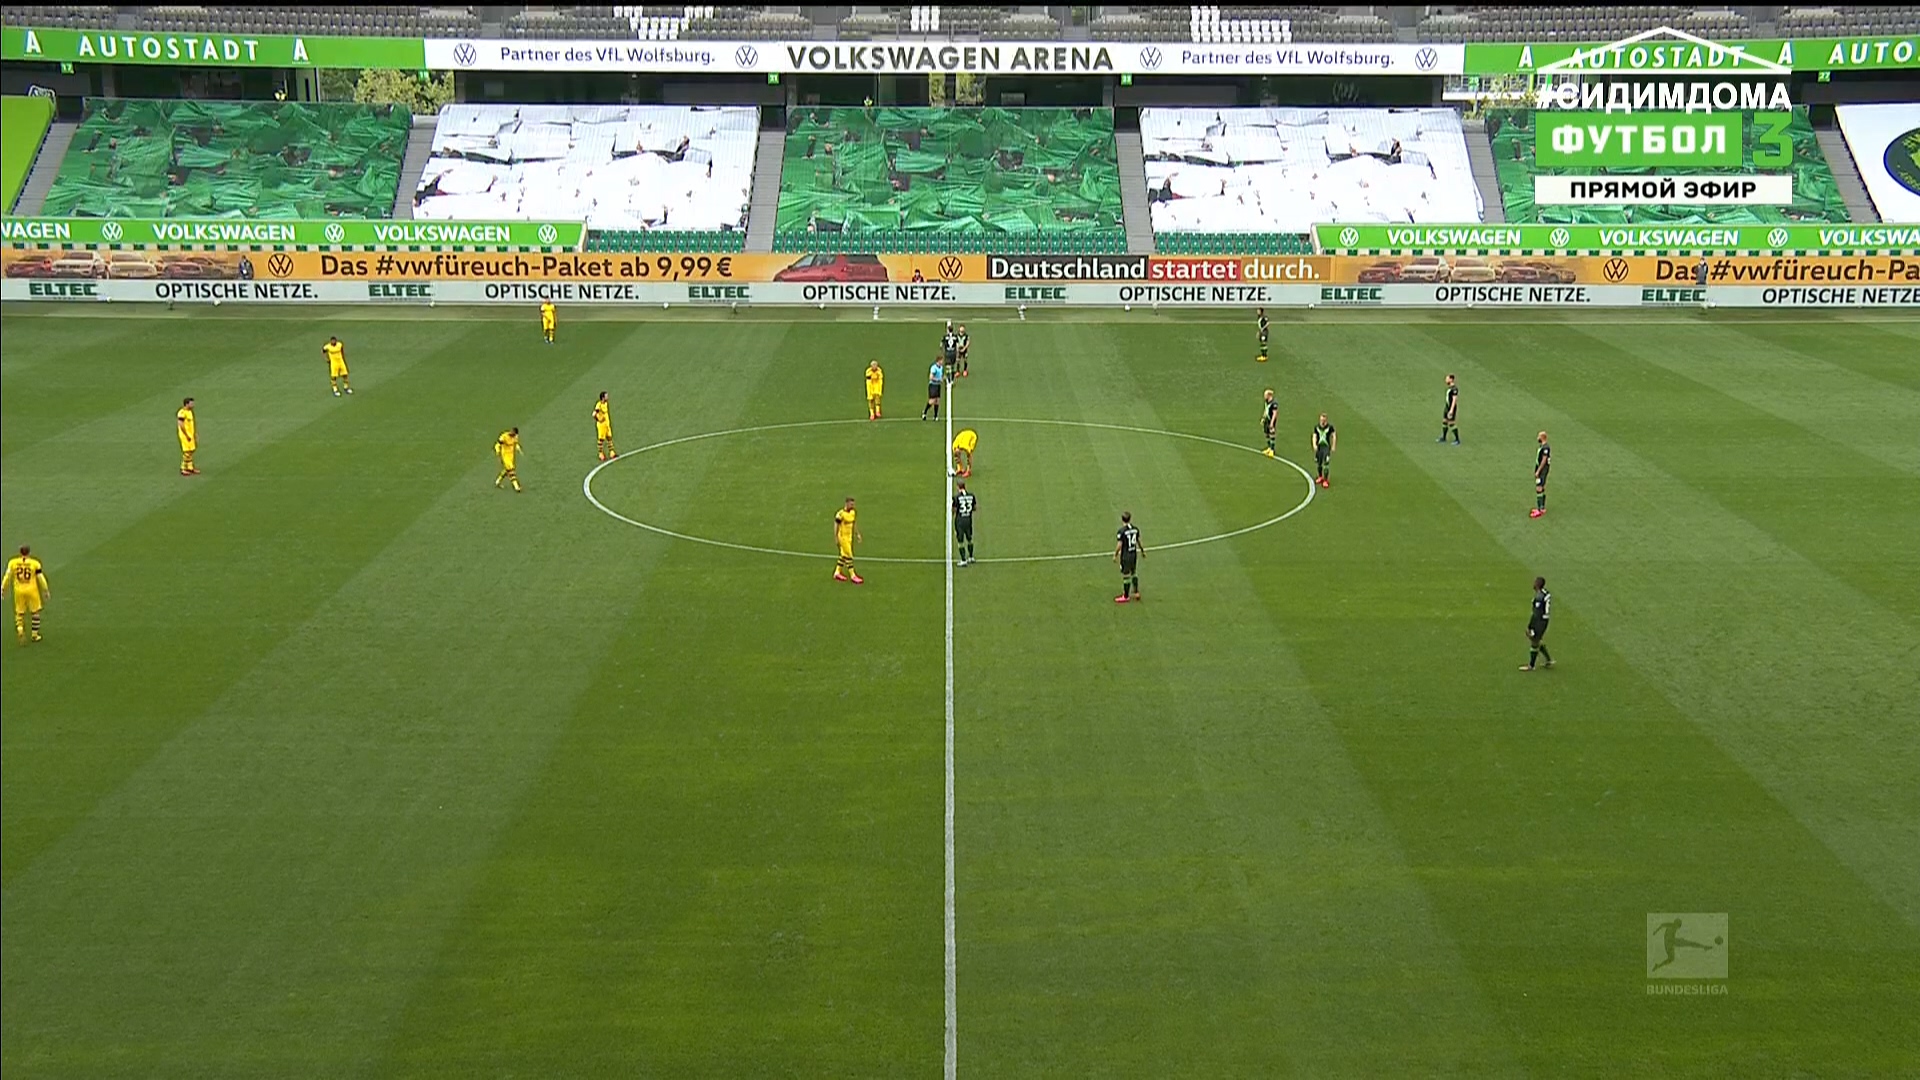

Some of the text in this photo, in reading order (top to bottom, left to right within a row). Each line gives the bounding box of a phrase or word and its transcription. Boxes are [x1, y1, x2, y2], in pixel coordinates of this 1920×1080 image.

[79, 35, 259, 61] AUTOSTADT
[501, 46, 715, 65] Partner des VfL Wolfsburg.
[1569, 46, 1745, 68] AUTOSTADT
[1828, 41, 1920, 64] AUTO
[787, 46, 1114, 70] VOLKSWAGEN ARENA
[1182, 50, 1395, 68] Partner des VfL Wolfsburg.
[153, 223, 295, 241] VOLKSWAGEN
[374, 226, 510, 242] VOLKSWAGEN
[1387, 229, 1520, 246] VOLKSWAGEN
[1599, 230, 1738, 246] VOLKSWAGEN
[321, 255, 368, 276] Das
[376, 255, 612, 277] #vwfüreuch-Paket
[620, 256, 649, 277] ab
[991, 258, 1320, 280] Deutschland startet durch.
[29, 282, 98, 296] ELTEC
[155, 283, 318, 299] OPTISCHE NETZE.
[369, 284, 431, 297] ELTEC
[485, 283, 639, 299] OPTISCHE NETZE.
[688, 286, 749, 298] ELTEC
[803, 285, 956, 301] OPTISCHE NETZE.
[1005, 287, 1066, 299] ELTEC
[1119, 286, 1272, 302] OPTISCHE NETZE.
[1321, 288, 1382, 300] ELTEC
[1436, 287, 1591, 302] OPTISCHE NETZE.
[1642, 289, 1706, 301] ELTEC
[1763, 288, 1920, 304] OPTISCHE NETZE
[959, 500, 973, 513] 33
[1126, 533, 1137, 547] 14
[16, 567, 31, 580] 26
